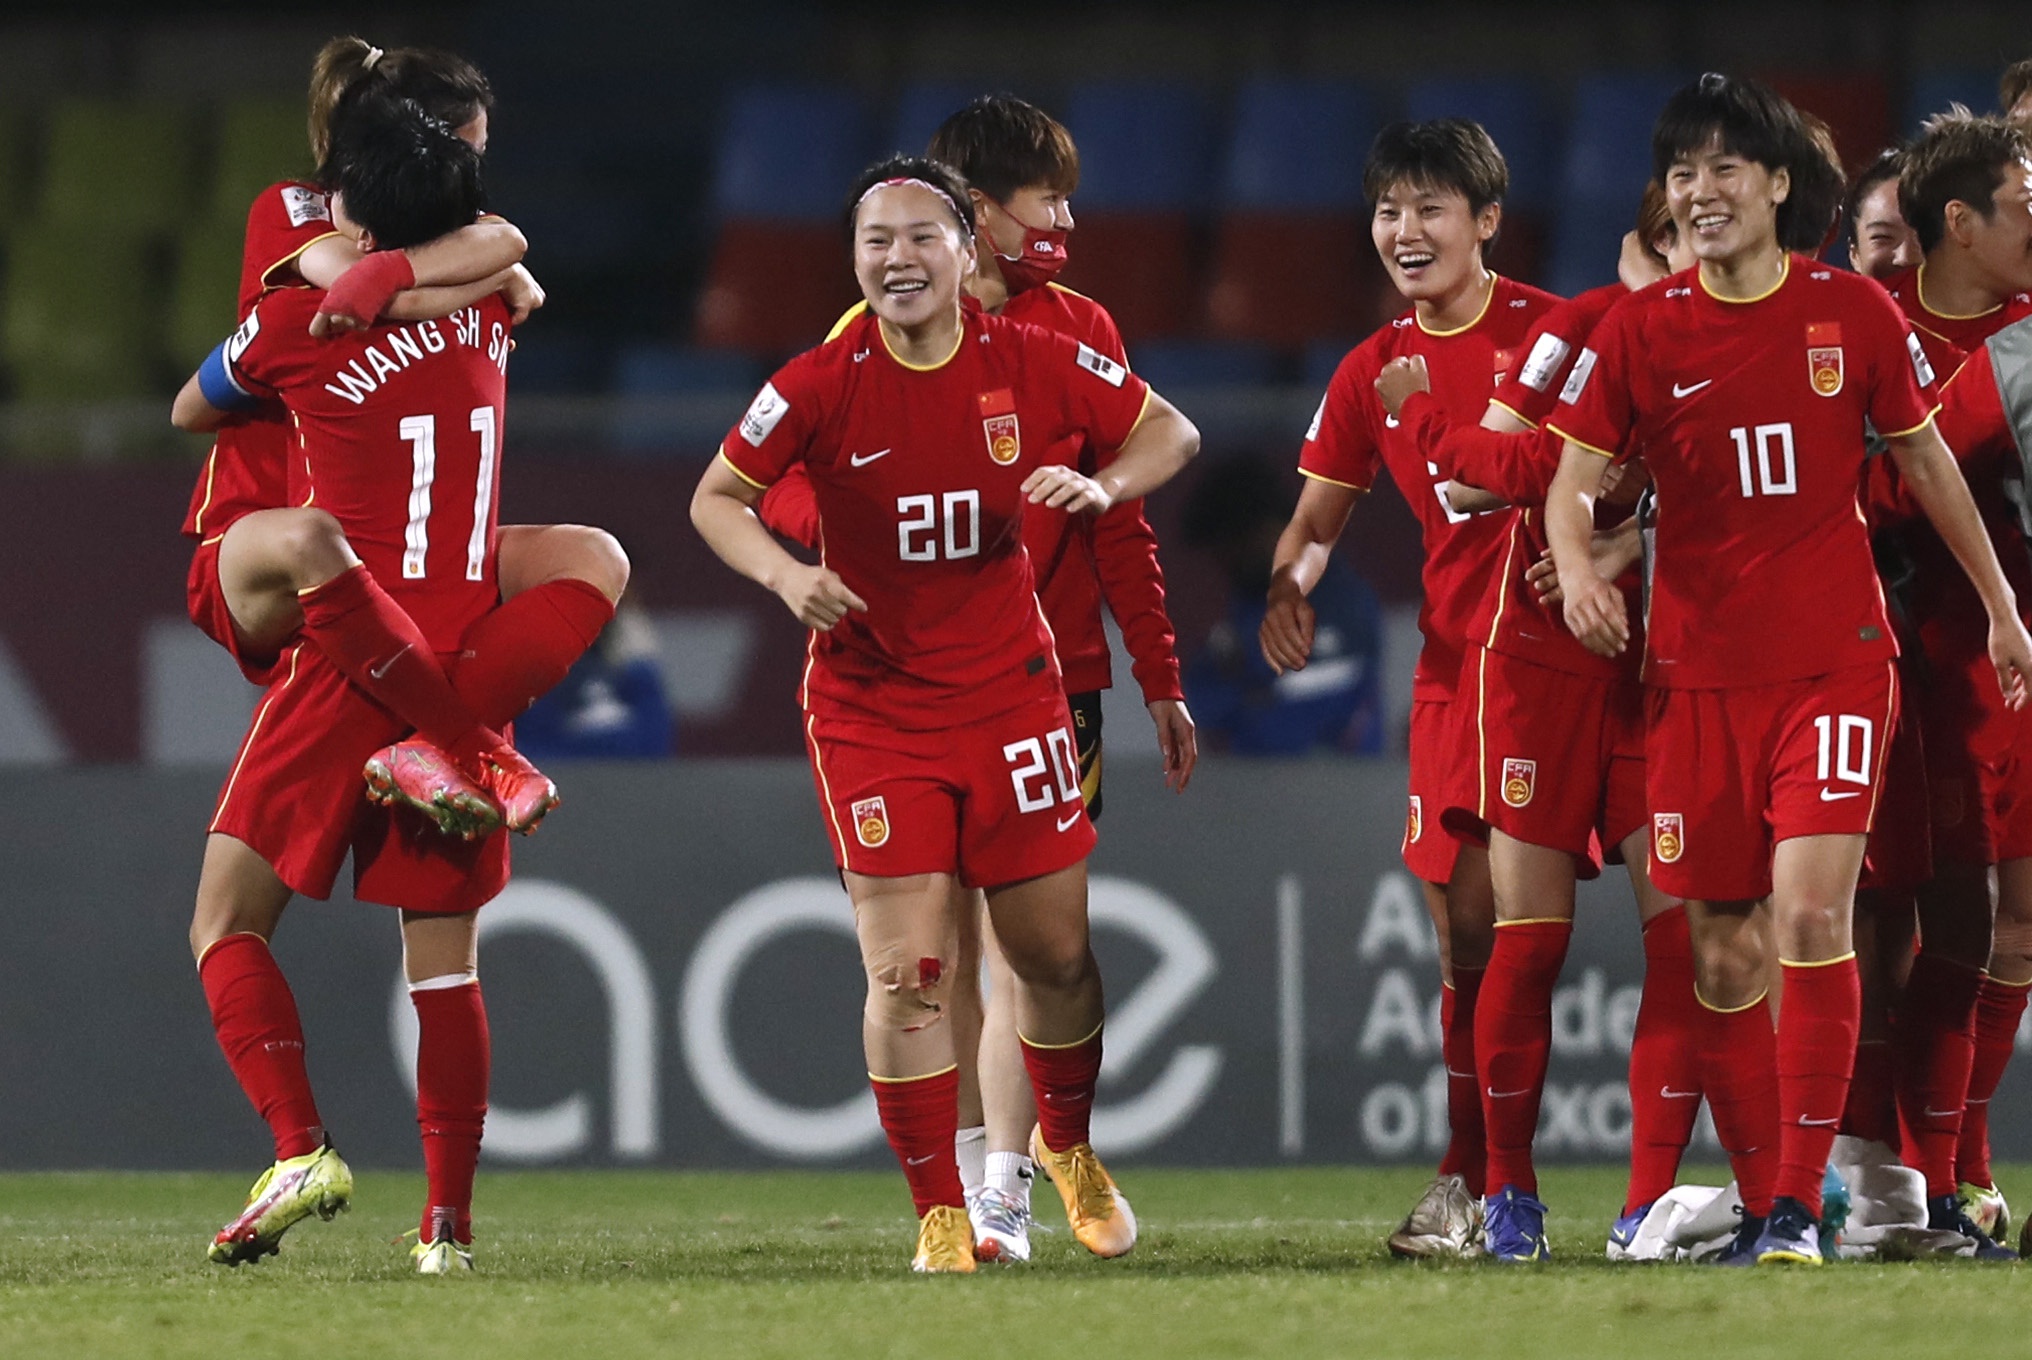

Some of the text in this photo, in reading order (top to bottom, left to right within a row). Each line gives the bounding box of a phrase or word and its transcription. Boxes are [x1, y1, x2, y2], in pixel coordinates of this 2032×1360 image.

[1034, 241, 1054, 252] CFA
[324, 319, 446, 405] WANG
[399, 405, 496, 582] 11
[1729, 422, 1797, 498] 10
[897, 488, 980, 561] 20
[1003, 727, 1082, 814] 20
[1814, 714, 1873, 786] 10
